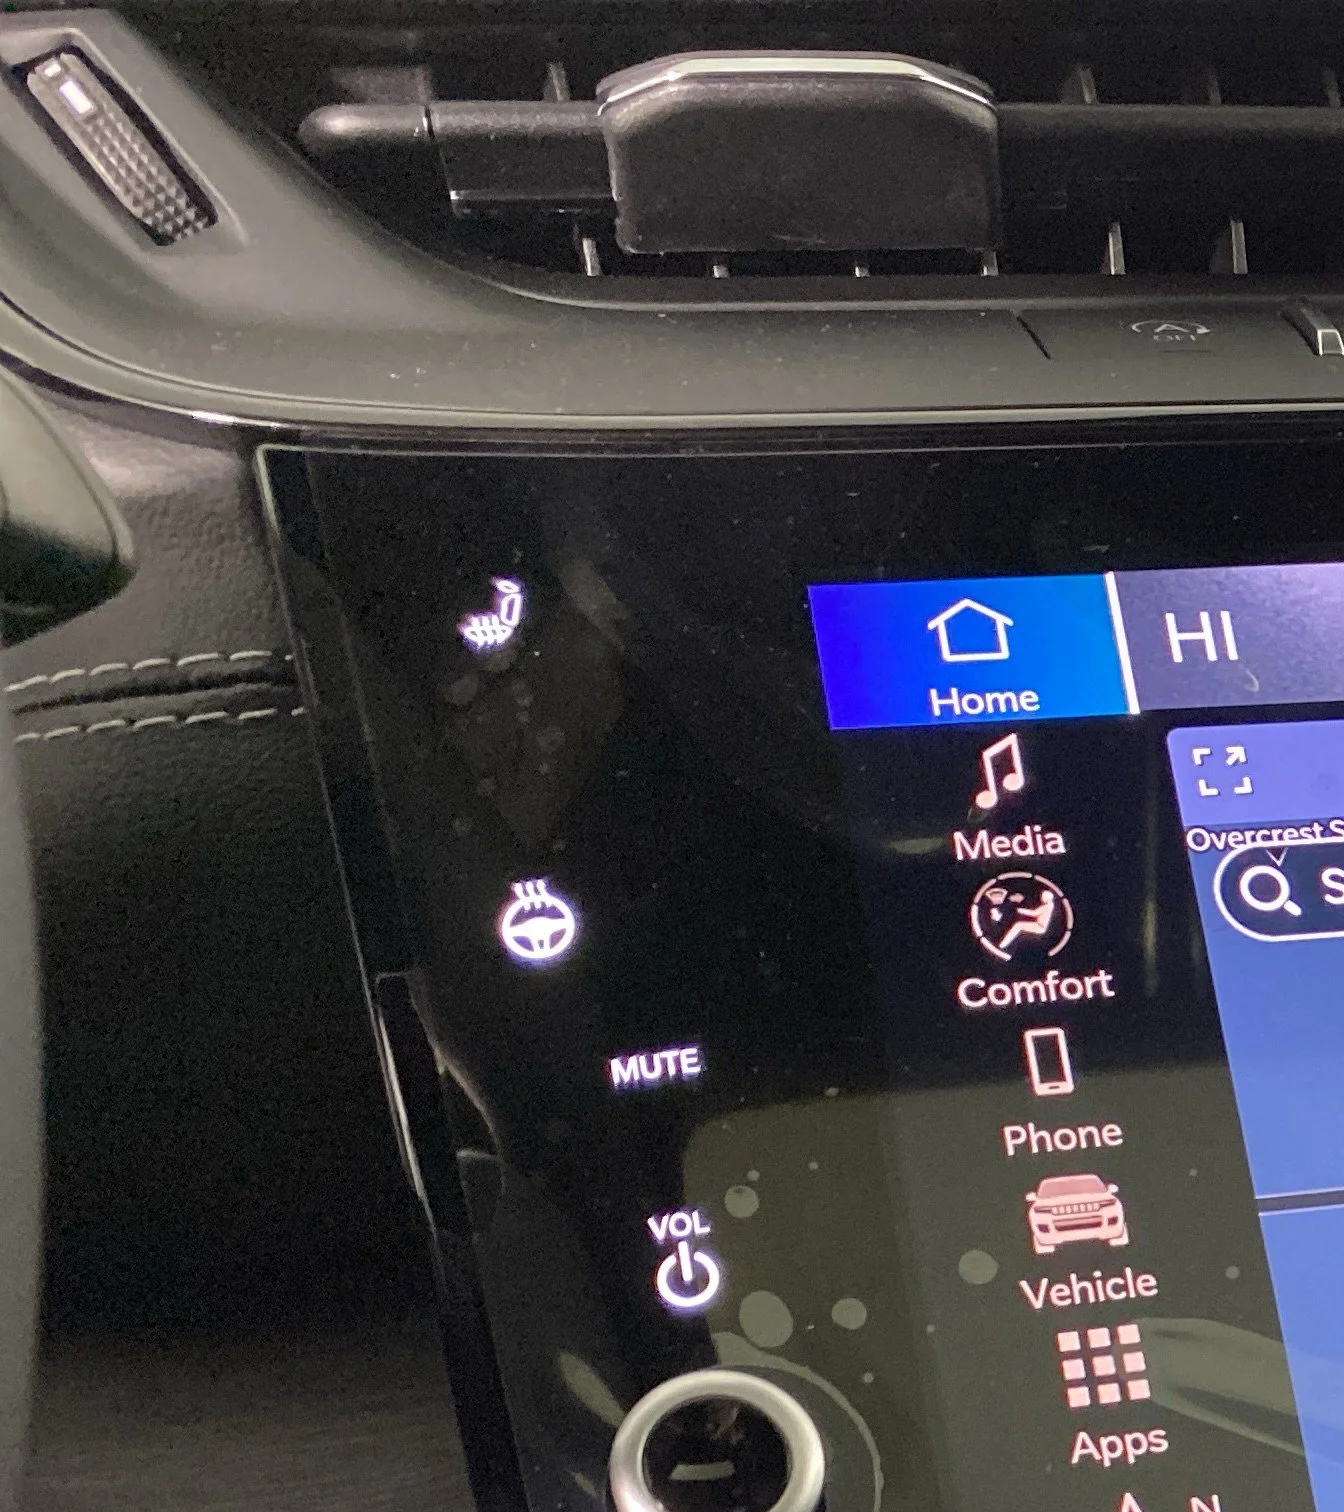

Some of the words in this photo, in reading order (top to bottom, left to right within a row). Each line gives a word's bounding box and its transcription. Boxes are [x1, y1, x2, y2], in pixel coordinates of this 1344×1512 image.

[1166, 610, 1240, 662] HI
[930, 686, 1040, 717] Home
[953, 825, 1066, 862] Media
[957, 969, 1116, 1010] Comfort
[610, 1048, 703, 1086] MUTE
[1003, 1120, 1124, 1156] Phone
[647, 1211, 711, 1241] VOL
[1020, 1266, 1159, 1311] Vehicle
[1070, 1428, 1170, 1469] Apps
